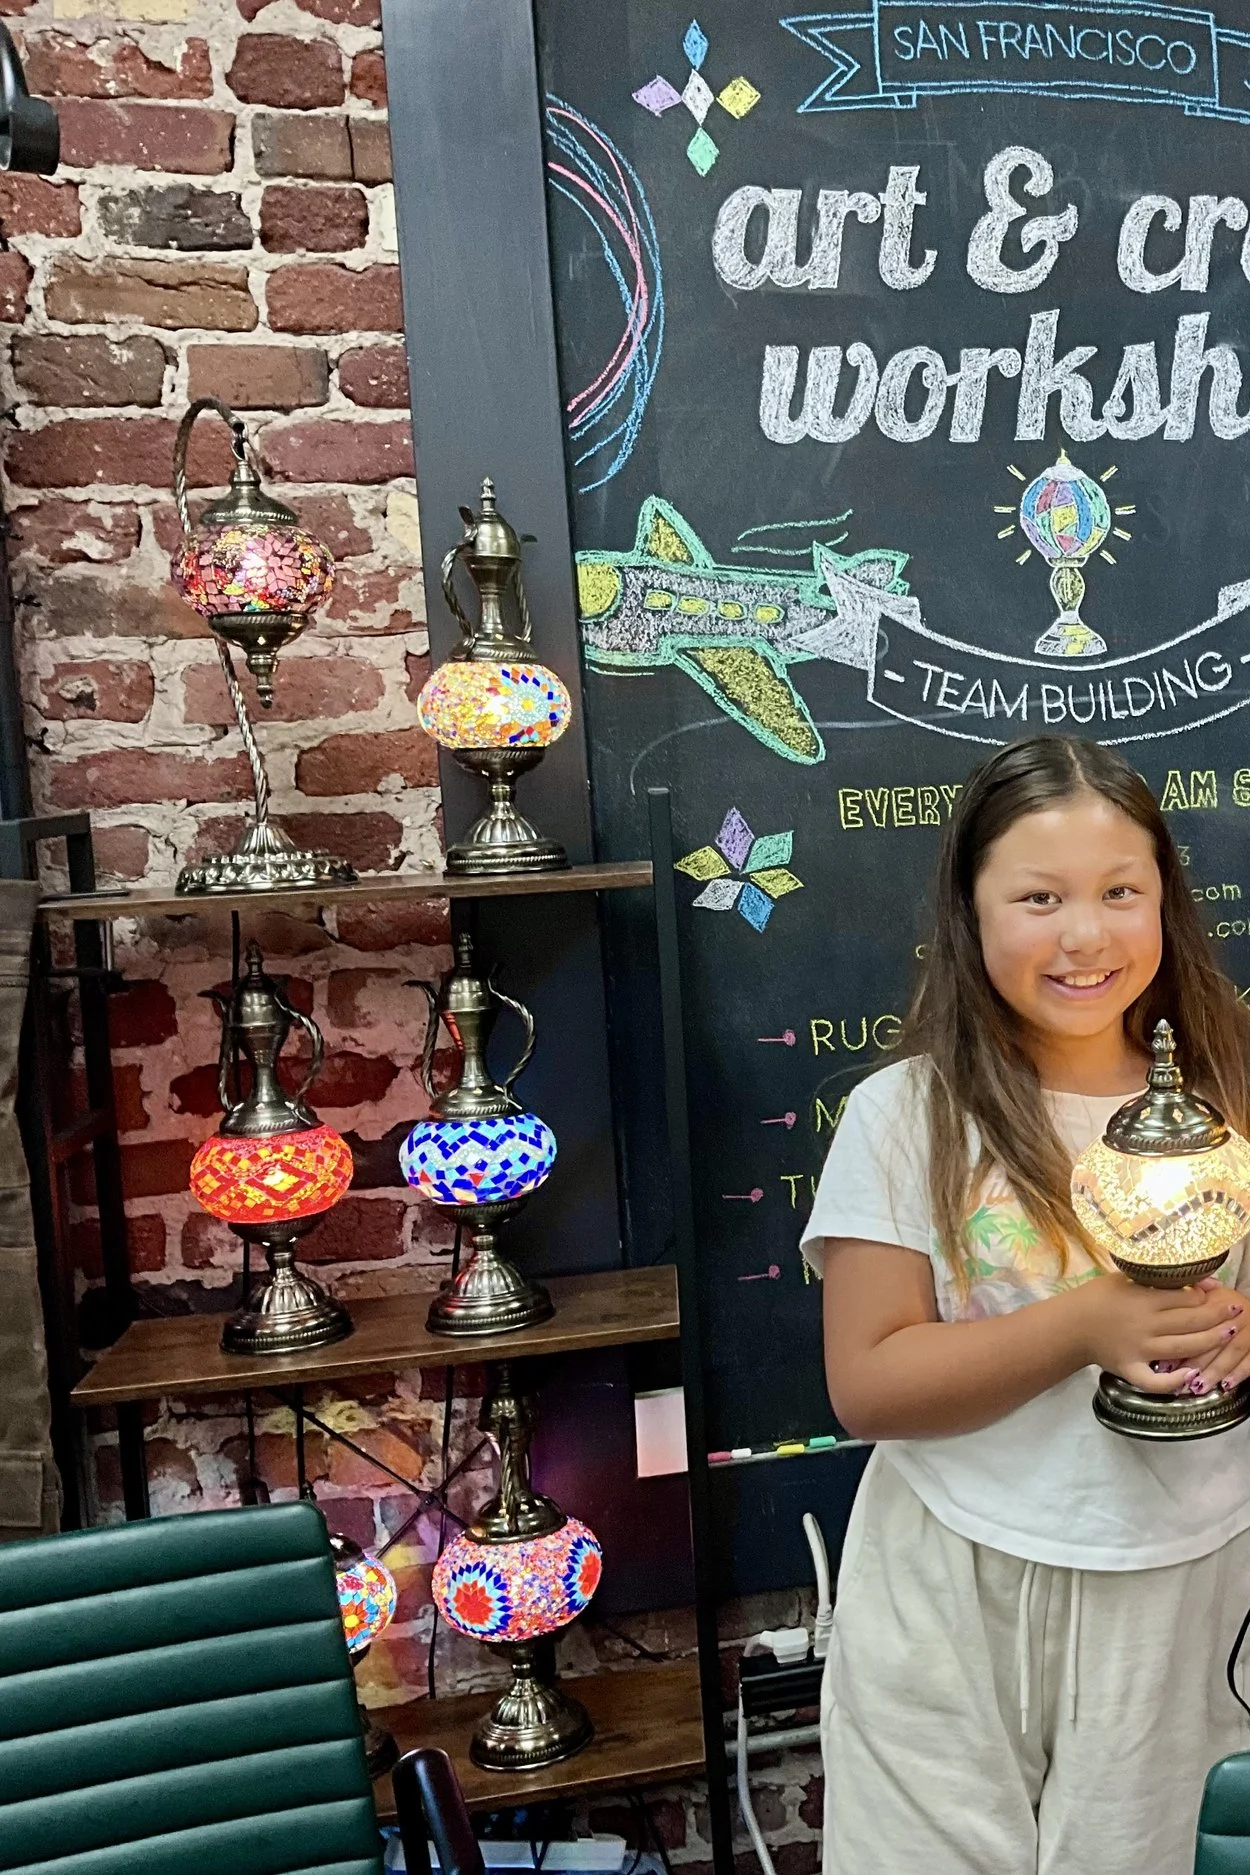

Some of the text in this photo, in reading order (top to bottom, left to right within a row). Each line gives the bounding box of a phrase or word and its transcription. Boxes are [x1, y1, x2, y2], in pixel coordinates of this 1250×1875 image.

[893, 19, 1197, 75] SAN FRANCISCO
[712, 164, 938, 291] art
[966, 145, 1079, 294] &
[1160, 770, 1218, 811] AM
